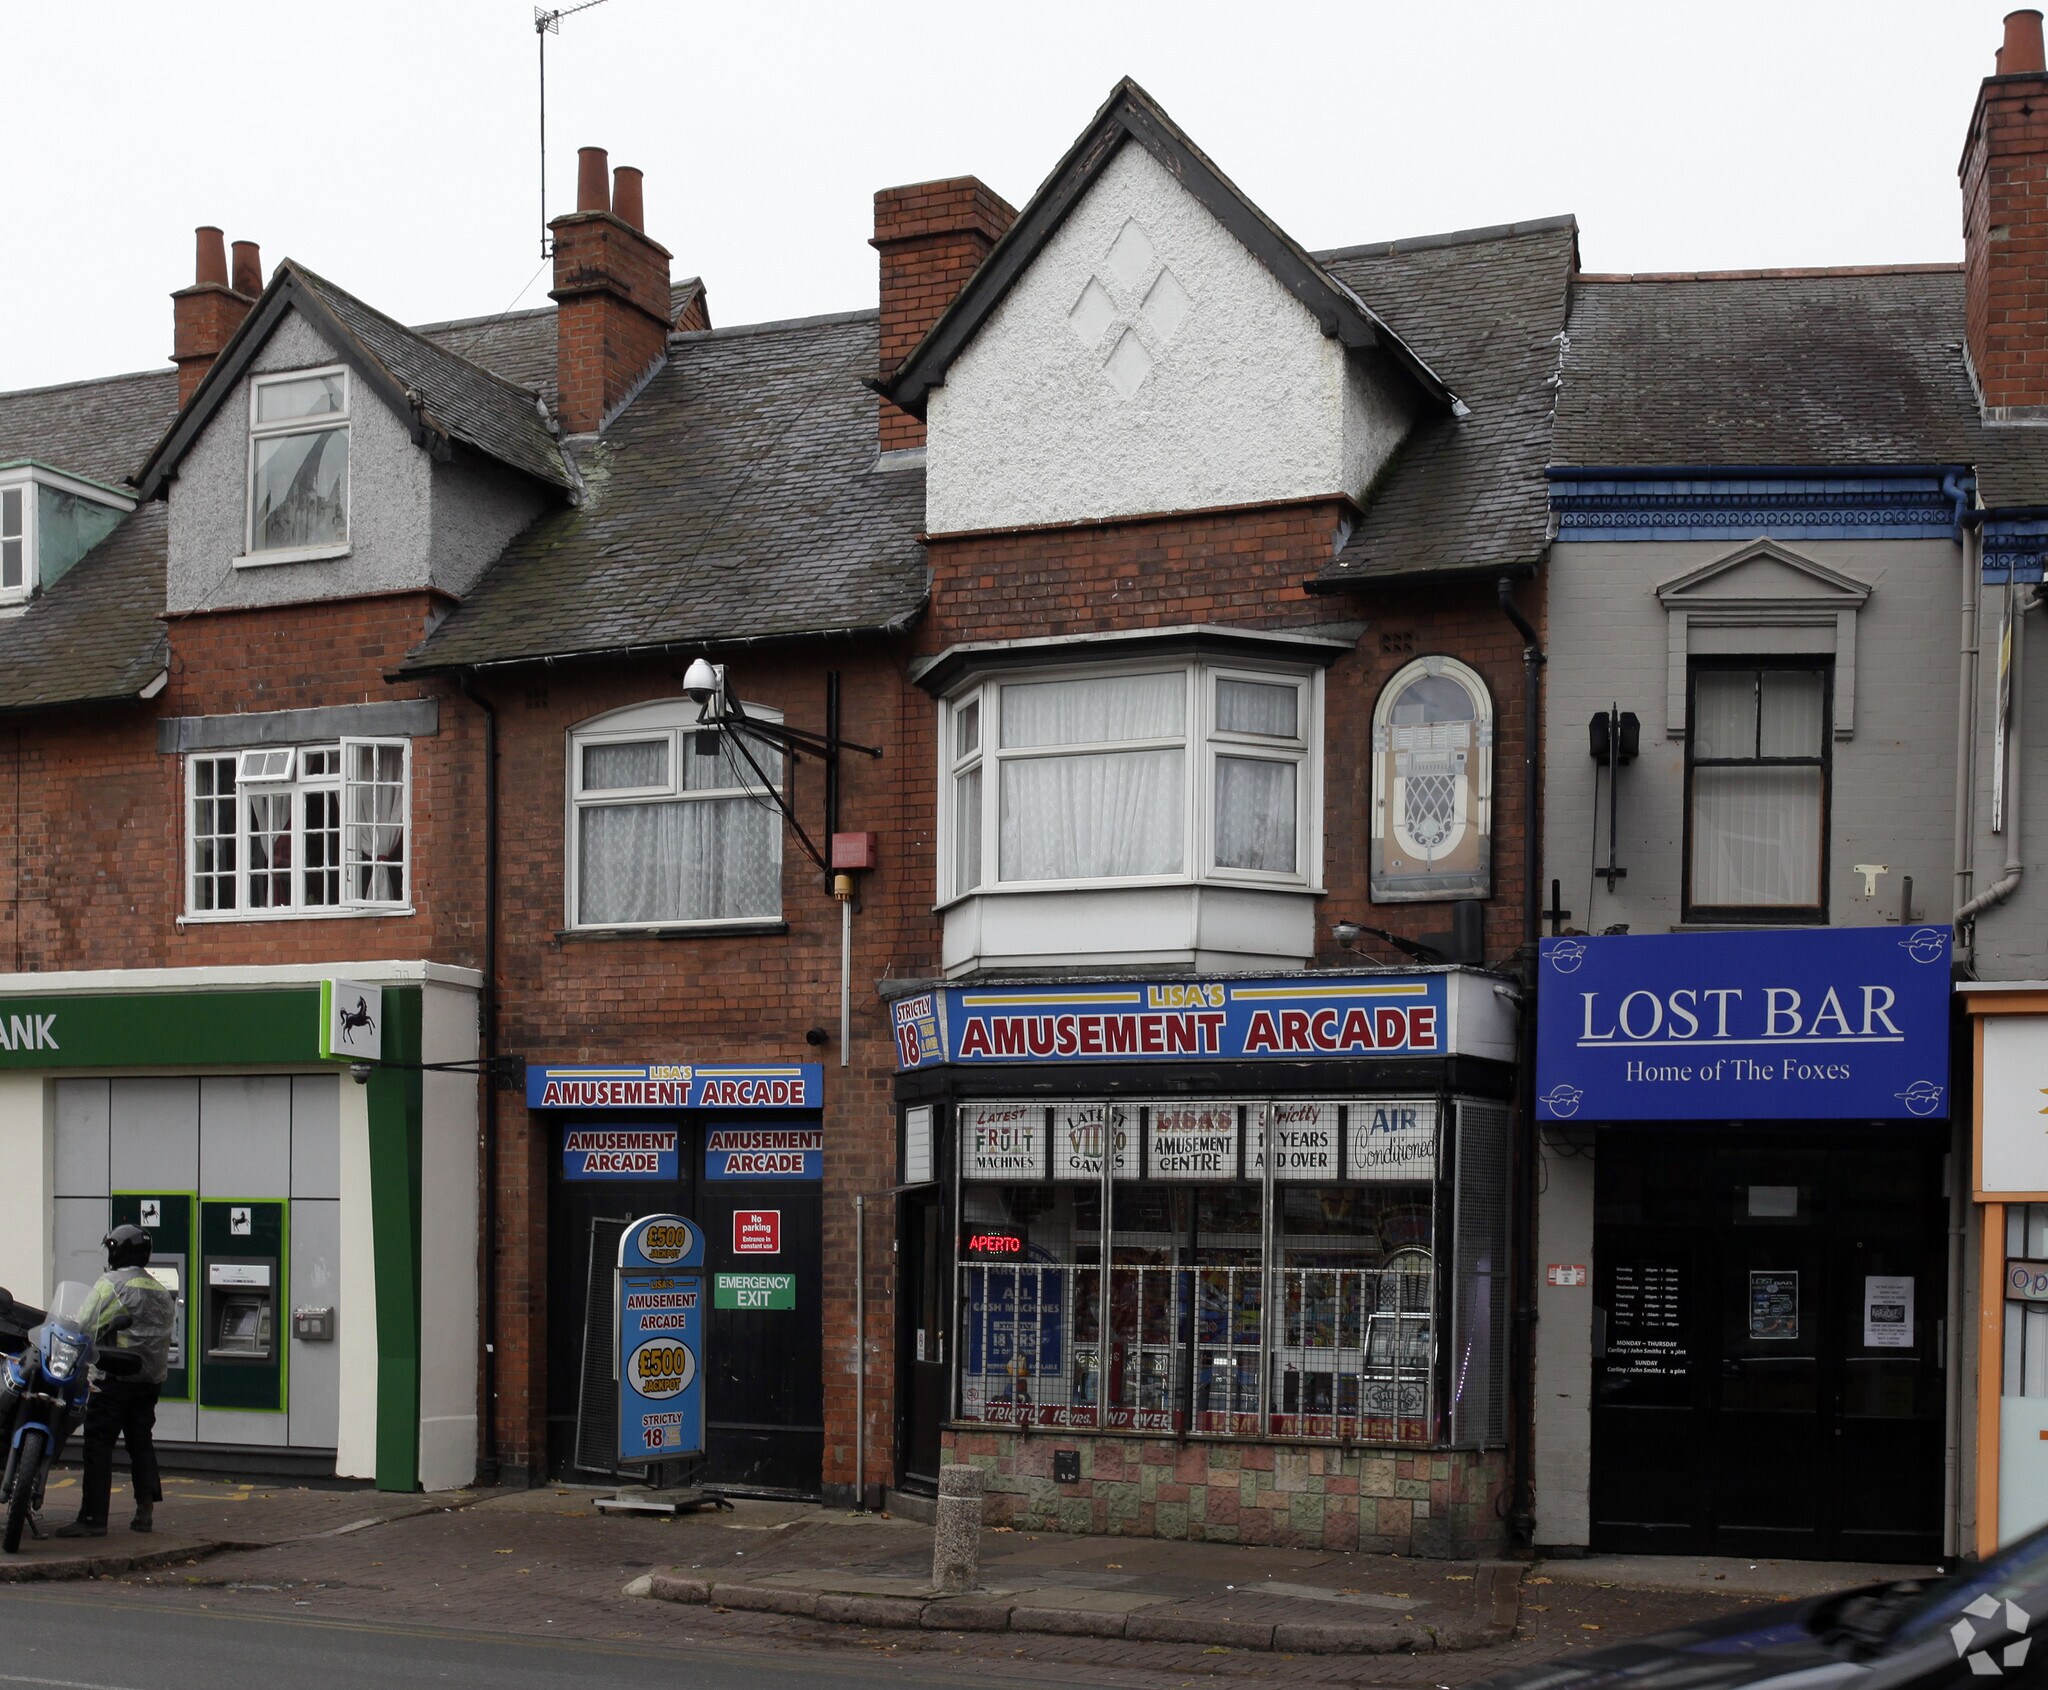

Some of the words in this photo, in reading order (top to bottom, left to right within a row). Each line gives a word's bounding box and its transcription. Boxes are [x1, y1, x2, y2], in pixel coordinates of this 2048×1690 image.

[1148, 984, 1225, 1009] LISA'S
[897, 994, 931, 1023] STRICTLY
[1578, 989, 1742, 1039] LOST
[1761, 985, 1903, 1037] BAR
[958, 1012, 1226, 1058] AMUSEMENT
[1242, 1006, 1437, 1054] ARCADE
[897, 1022, 920, 1068] 18
[650, 1066, 692, 1080] LISA'S
[1626, 1060, 1692, 1082] Home
[1700, 1059, 1726, 1081] of
[1731, 1059, 1774, 1081] The
[1782, 1059, 1850, 1081] Foxes
[542, 1081, 693, 1106] AMUSEMENT
[700, 1080, 805, 1105] ARCADE
[977, 1108, 1028, 1125] LATEST
[1154, 1108, 1232, 1133] LISA'S
[1370, 1108, 1417, 1135] AIR
[564, 1132, 677, 1151] AMUSEMENT
[707, 1131, 823, 1152] AMUSEMENT
[976, 1127, 1034, 1153] FRUIT
[1069, 1124, 1127, 1158] VIDO
[1154, 1137, 1232, 1154] AMUSEMENT
[1280, 1132, 1328, 1147] YEARS
[1355, 1125, 1438, 1168] Conditioned
[583, 1152, 658, 1173] ARCADE
[724, 1153, 804, 1174] ARCADE
[977, 1156, 1034, 1169] MACHINES
[1070, 1155, 1124, 1173] GAMS
[1160, 1152, 1222, 1171] CENTRE
[1255, 1152, 1286, 1168] AD
[1291, 1152, 1328, 1168] OVER
[742, 1223, 771, 1233] parking
[751, 1214, 762, 1223] No
[647, 1226, 685, 1248] £500
[969, 1235, 1021, 1252] APERTO
[649, 1249, 680, 1259] JACKPOT
[651, 1279, 675, 1289] LISA'S
[719, 1276, 791, 1289] EMERGENCY
[627, 1293, 697, 1309] AMUSEMENT
[737, 1291, 772, 1307] EXIT
[640, 1314, 686, 1331] ARCADE
[638, 1347, 685, 1378] £500
[643, 1378, 681, 1393] JACKPOT
[642, 1412, 683, 1427] STRICTLY
[1107, 1413, 1128, 1425] ND
[643, 1427, 663, 1449] 18
